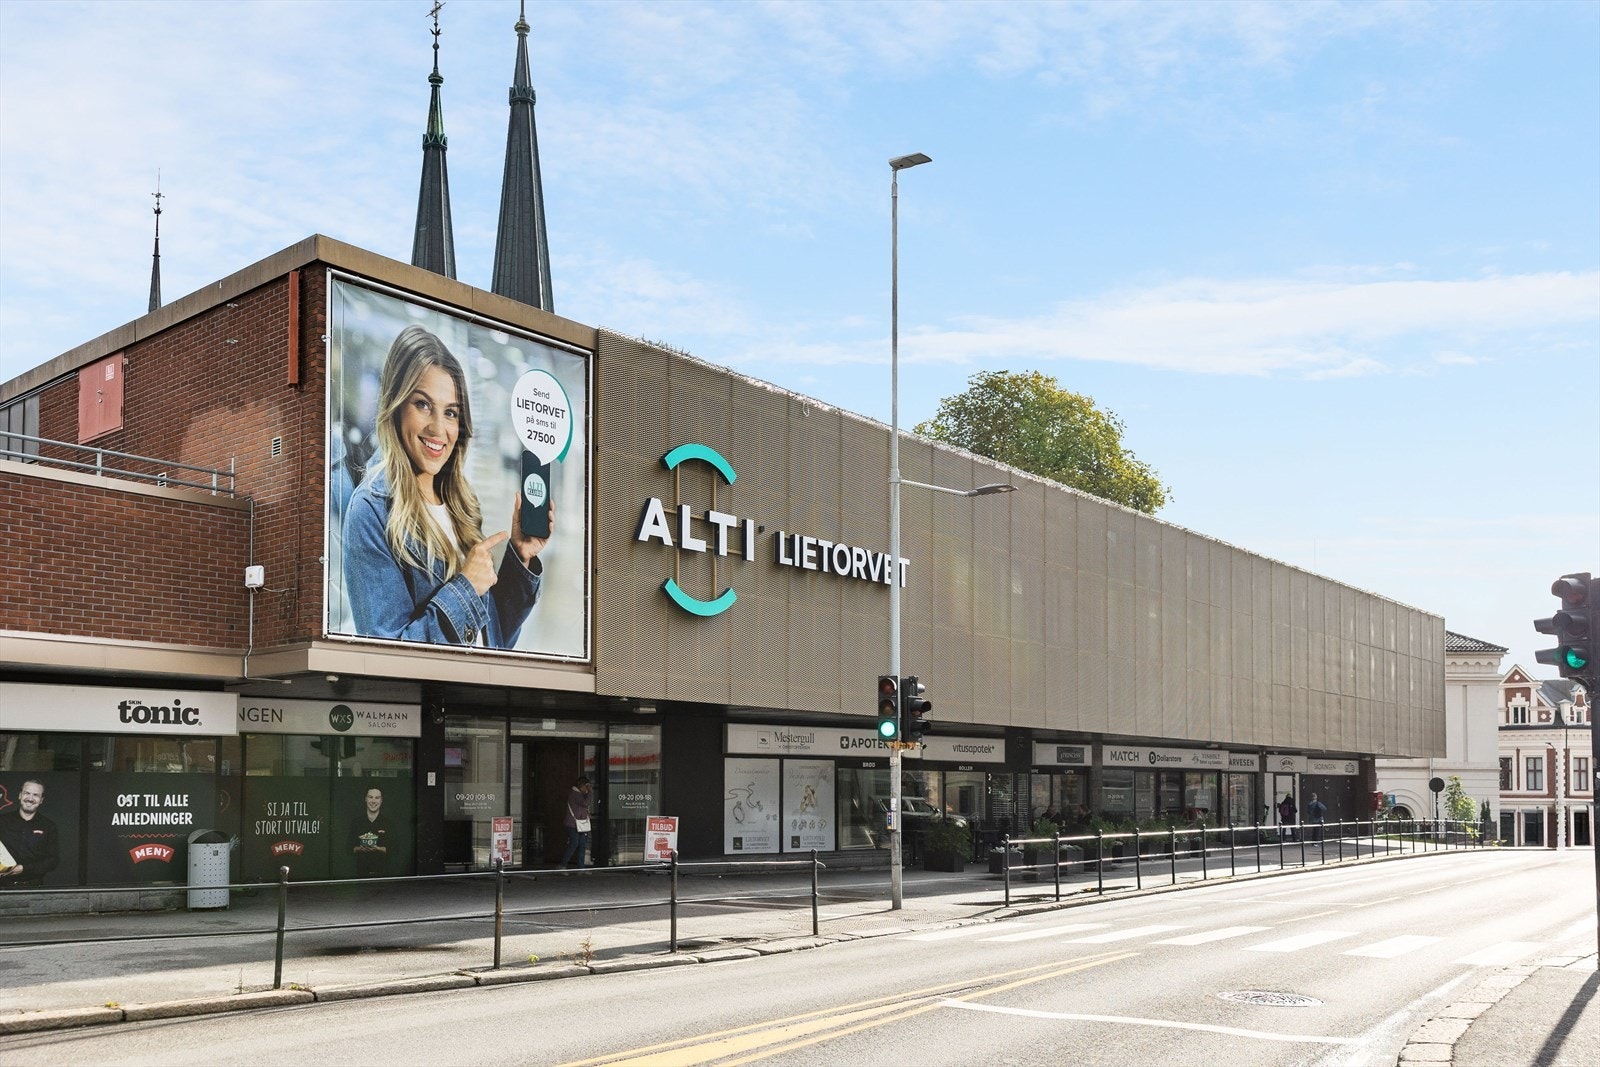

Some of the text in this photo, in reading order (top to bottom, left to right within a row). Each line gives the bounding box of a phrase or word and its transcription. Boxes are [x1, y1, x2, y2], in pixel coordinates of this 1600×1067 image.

[533, 387, 550, 400] Send
[516, 397, 566, 419] LIETORVET
[526, 415, 535, 425] på
[536, 418, 549, 428] sms
[527, 429, 556, 445] 27500
[636, 497, 755, 562] ALTI
[776, 530, 910, 588] LIETORVET
[118, 698, 199, 726] tonic
[356, 711, 408, 720] WALMANN
[774, 731, 815, 746] Mestergull
[1110, 750, 1139, 762] MATCH
[1156, 754, 1182, 763] Dollarstore
[117, 794, 189, 807] OST TIL ALLE
[455, 793, 474, 801] 09-20
[267, 801, 309, 816] SI JA TIL
[111, 812, 193, 826] ANLEDNINGER
[255, 820, 320, 835] STORT UTVALG!
[651, 822, 674, 831] TILBUD
[134, 847, 171, 859] MENY
[274, 843, 301, 853] MENY
